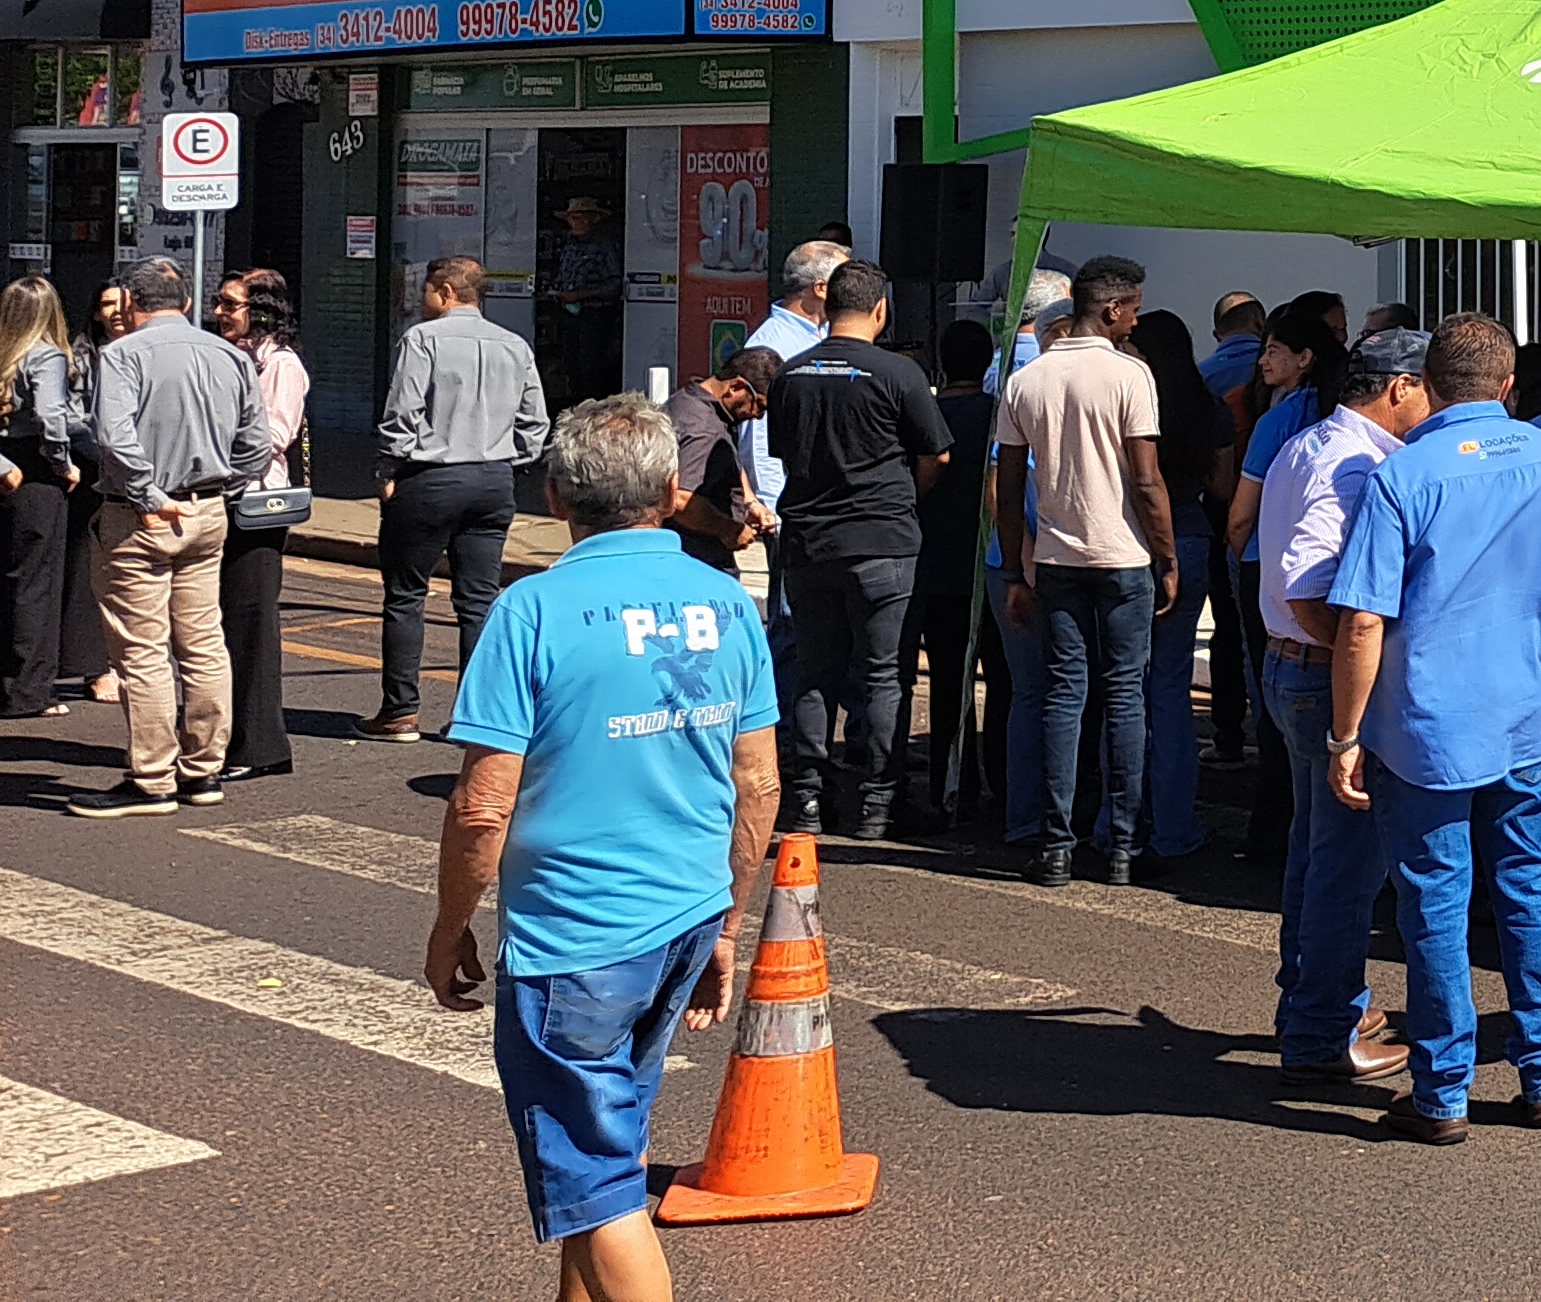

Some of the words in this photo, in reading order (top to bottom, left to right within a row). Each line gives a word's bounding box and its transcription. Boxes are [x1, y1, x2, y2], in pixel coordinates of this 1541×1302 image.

[244, 29, 310, 51] Disk-Entregas
[316, 23, 335, 48] (34)
[338, 4, 438, 45] 3412-4004
[710, 13, 799, 30] 99978-4582
[192, 129, 210, 153] E
[330, 119, 364, 162] 643
[687, 151, 768, 174] DESCONTO
[171, 194, 228, 203] DESCARGA
[177, 184, 213, 193] CARGA
[217, 183, 224, 191] E
[621, 604, 720, 656] P-B
